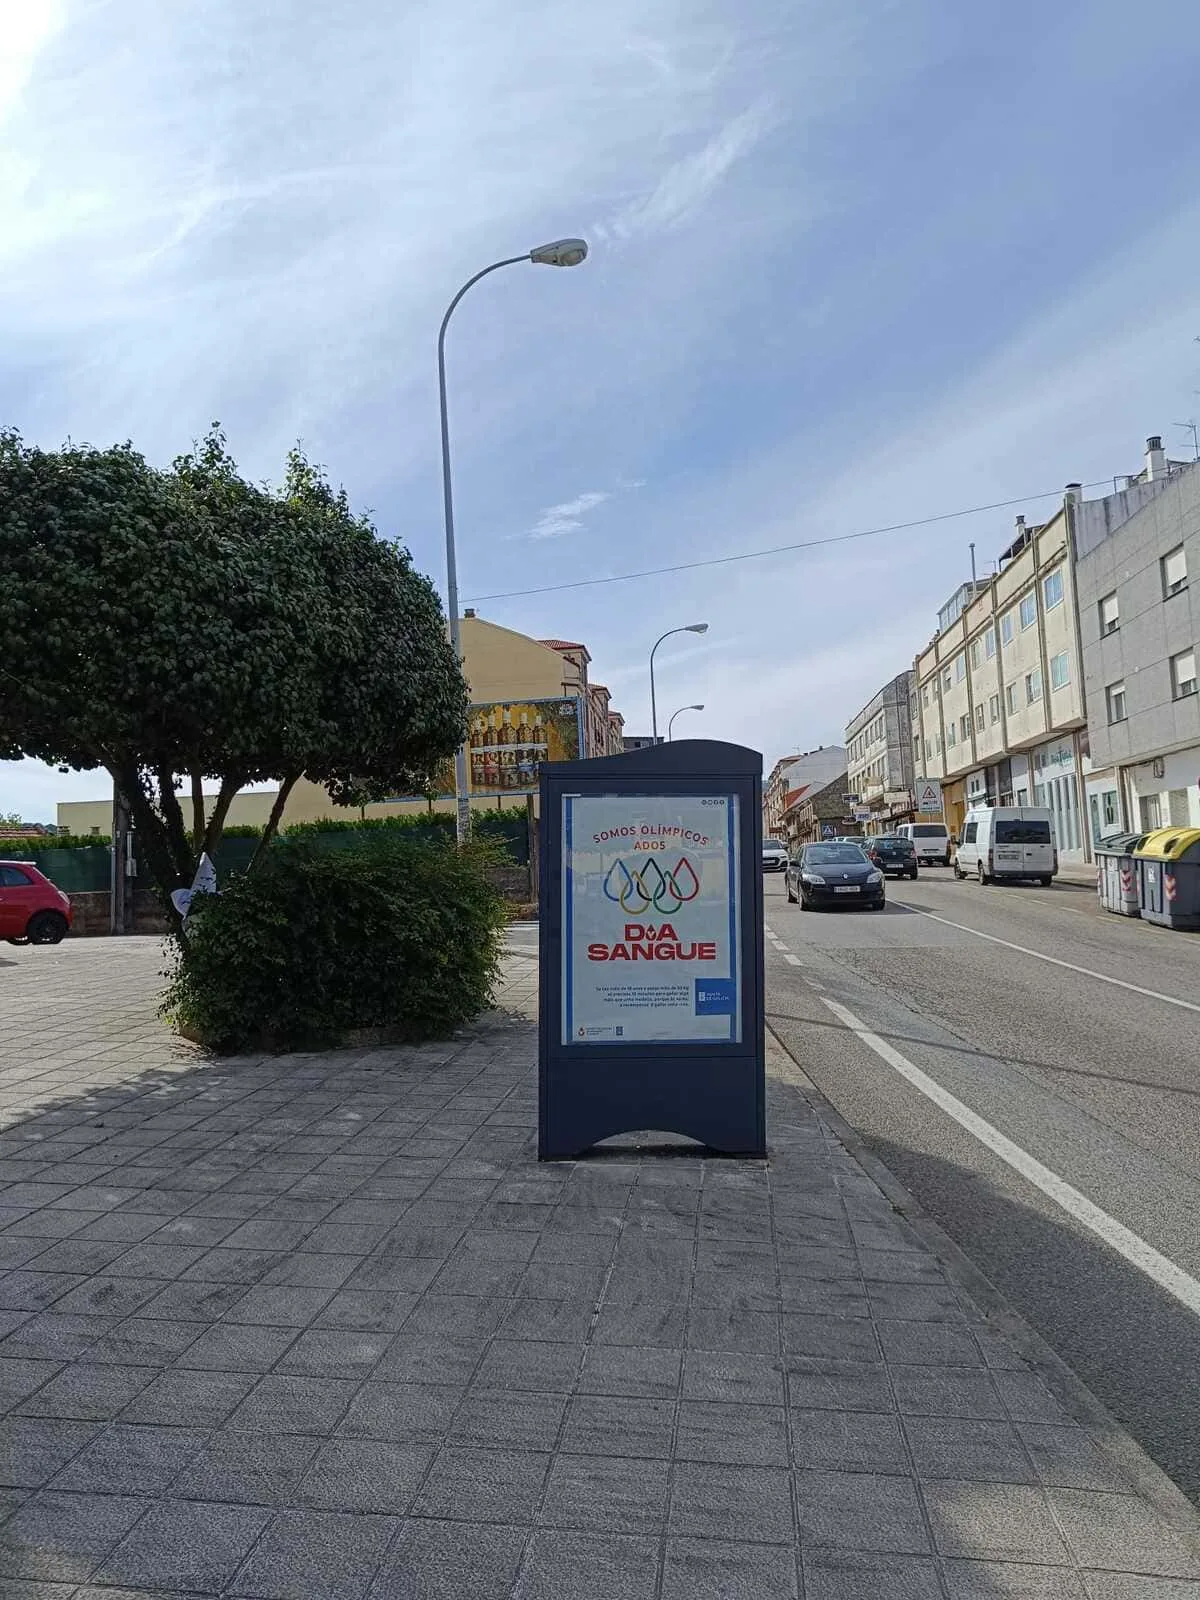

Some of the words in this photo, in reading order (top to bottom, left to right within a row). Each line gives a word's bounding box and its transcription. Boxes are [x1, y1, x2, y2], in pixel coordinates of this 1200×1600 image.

[592, 826, 636, 844] SOMOS
[640, 823, 709, 846] OLÍMPICOS
[633, 840, 666, 850] ADOS
[587, 942, 716, 961] SANGUE
